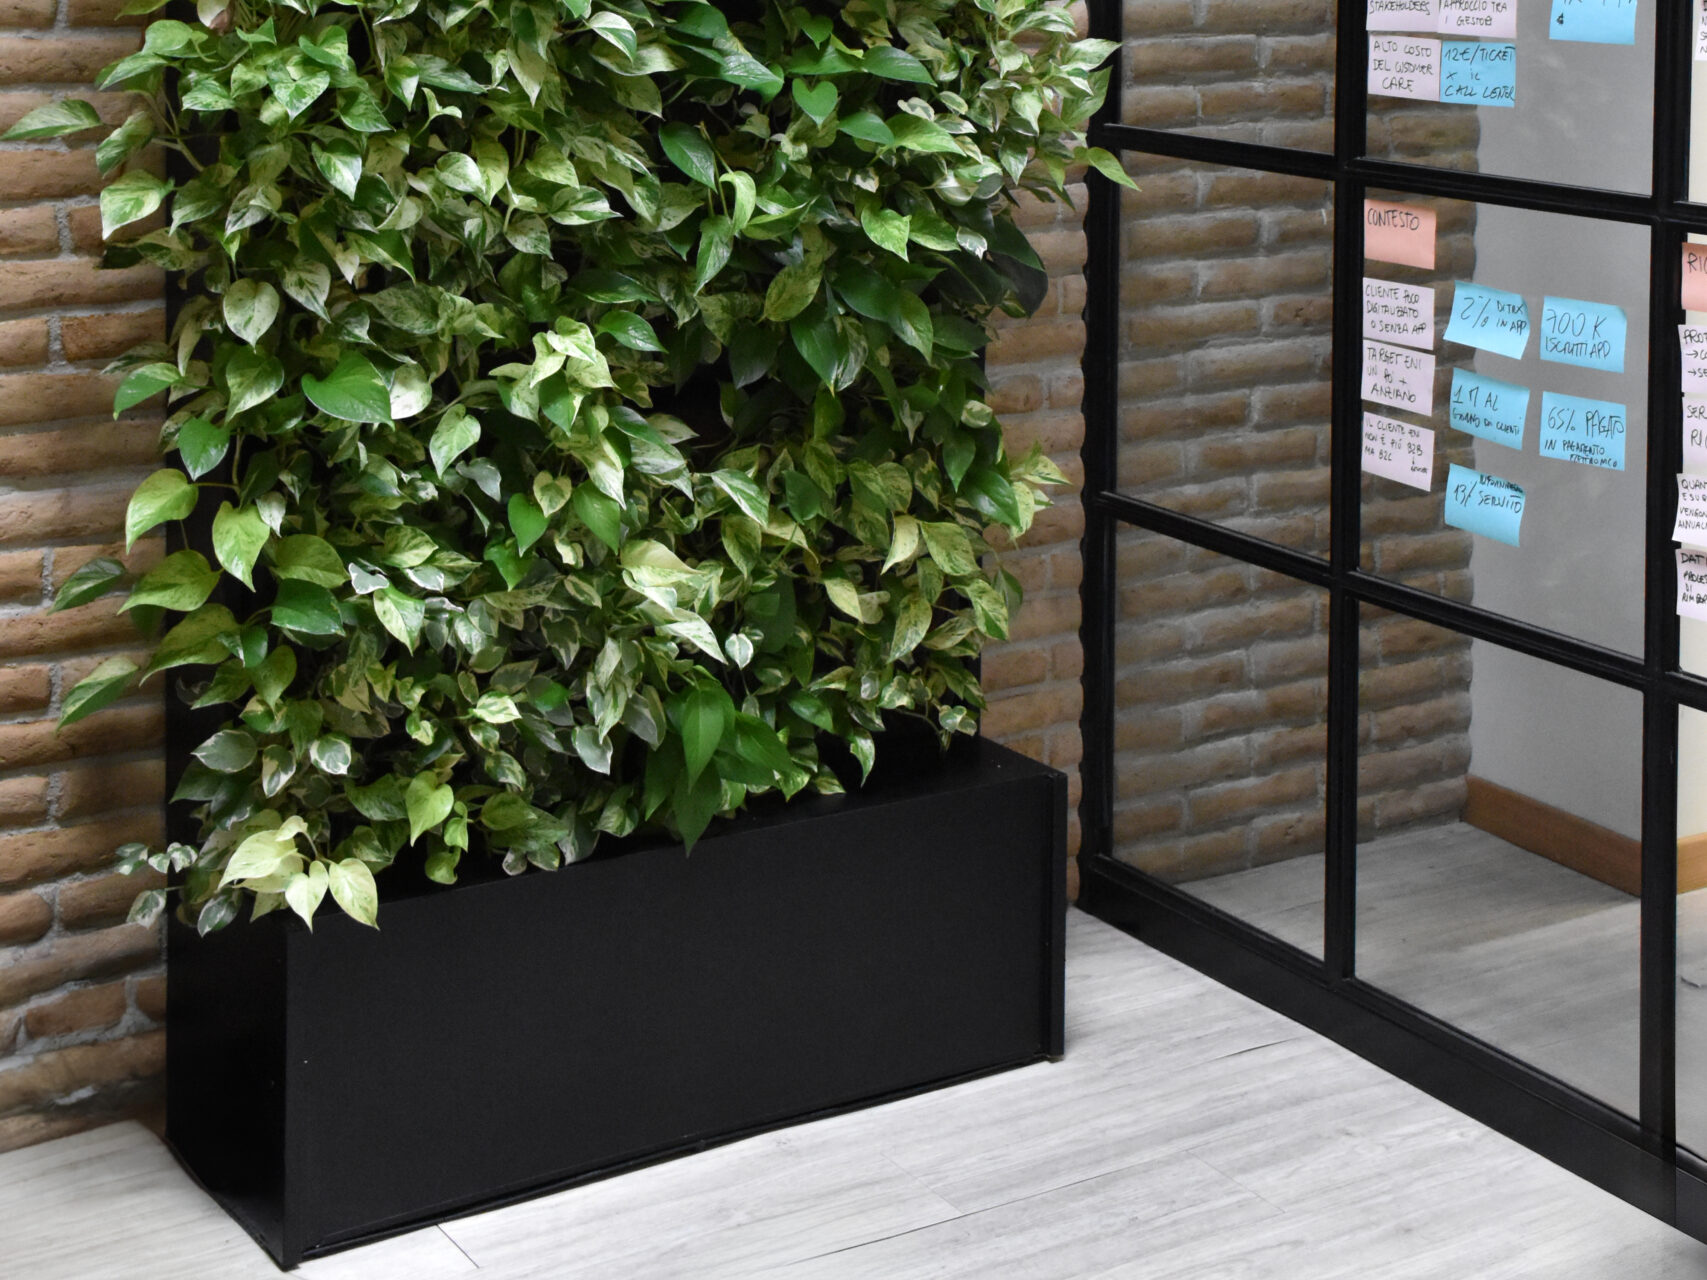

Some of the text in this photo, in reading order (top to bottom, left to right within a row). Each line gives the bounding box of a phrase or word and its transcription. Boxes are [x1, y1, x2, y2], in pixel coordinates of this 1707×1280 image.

[1491, 1, 1508, 13] TRA
[1373, 40, 1432, 58] ALTO COSTO
[1373, 59, 1391, 72] DEL
[1382, 76, 1414, 93] CARE
[1444, 86, 1477, 98] CALL
[1367, 208, 1420, 231] CONTESTO
[1365, 284, 1400, 300] CLIENTE
[1509, 319, 1527, 336] APP
[1367, 347, 1422, 371] TARGET ENI
[1370, 383, 1417, 403] ANZIANO
[1544, 439, 1557, 450] IN
